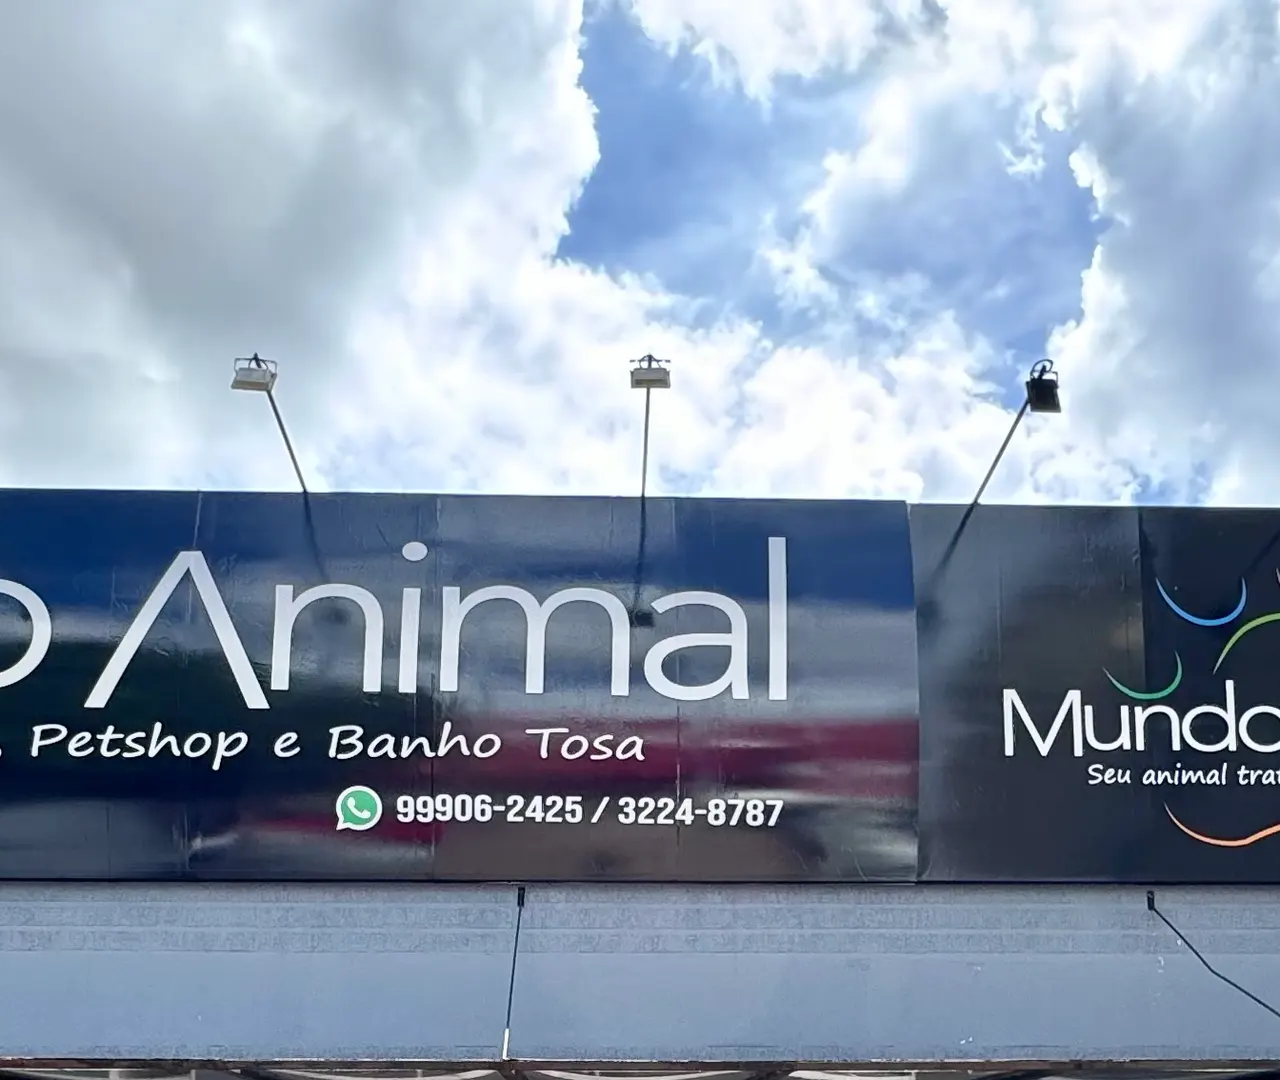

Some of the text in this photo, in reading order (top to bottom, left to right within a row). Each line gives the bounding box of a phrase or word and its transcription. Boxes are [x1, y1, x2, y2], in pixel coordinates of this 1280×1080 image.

[83, 536, 789, 710] Animal
[30, 721, 248, 771] Petshop
[274, 733, 301, 758] e
[328, 721, 502, 760] Banho
[524, 727, 646, 762] Tosa
[1087, 763, 1131, 785] Seu
[1142, 762, 1228, 786] animal
[396, 793, 584, 823] 99906-2425
[617, 796, 784, 828] 3224-8787
